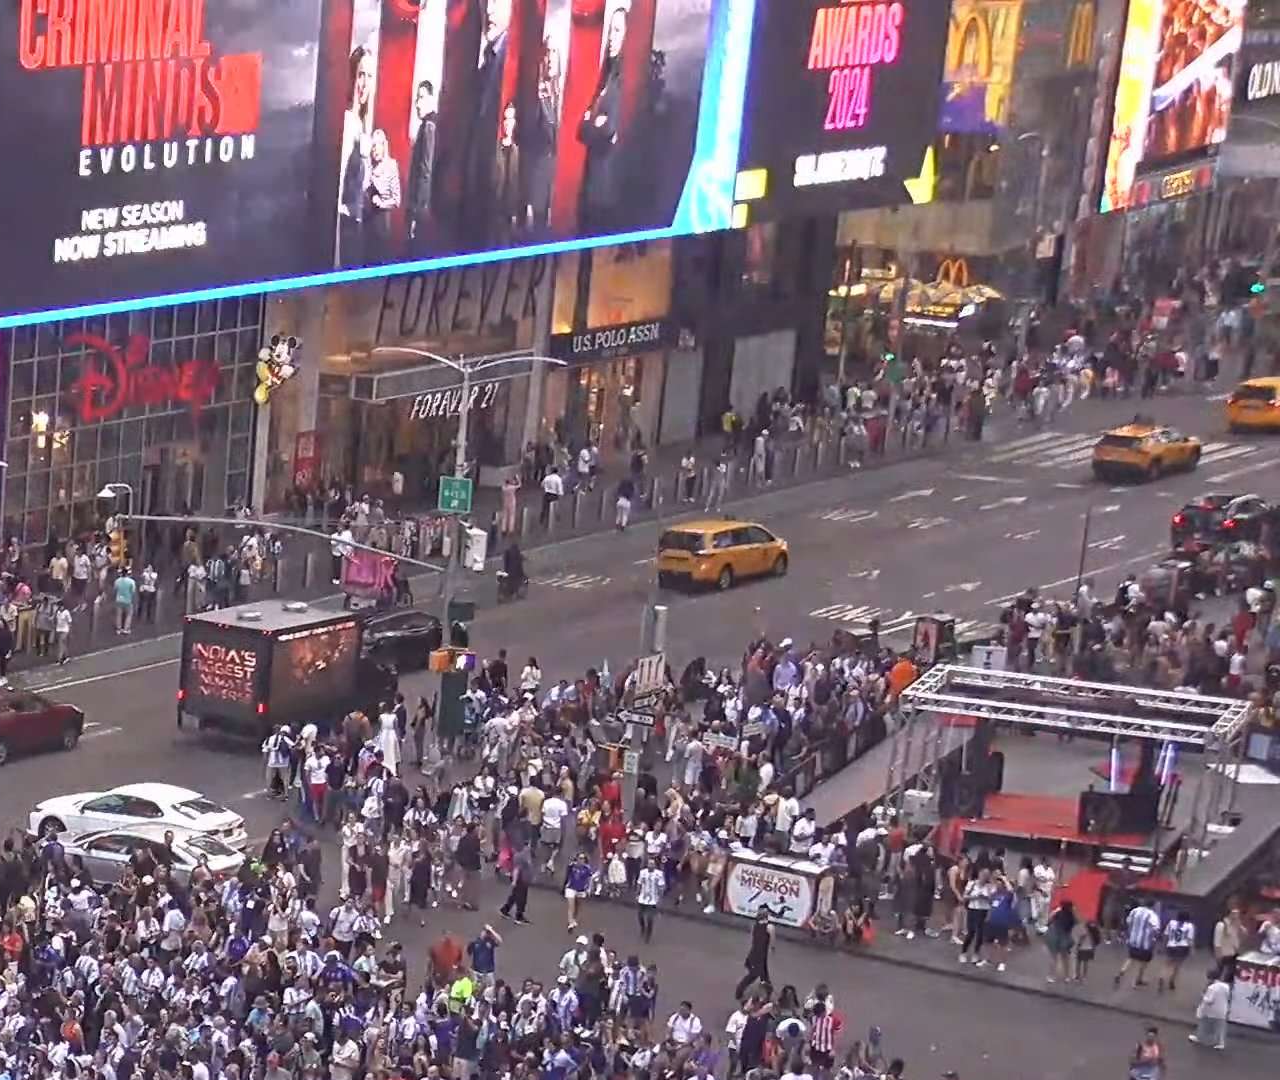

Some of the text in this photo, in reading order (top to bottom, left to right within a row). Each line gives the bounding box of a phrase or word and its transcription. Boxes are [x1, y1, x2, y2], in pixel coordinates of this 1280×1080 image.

[807, 3, 904, 70] AWARDS
[824, 66, 872, 130] 2024
[78, 133, 256, 177] EVOLUTION
[80, 199, 184, 232] NEW SEASON
[54, 221, 207, 264] NOW STREAMING
[594, 329, 625, 349] POLO
[627, 322, 659, 344] ASSN
[481, 382, 500, 409] 21
[192, 642, 257, 667] INDIA'S
[739, 875, 800, 898] MISSION
